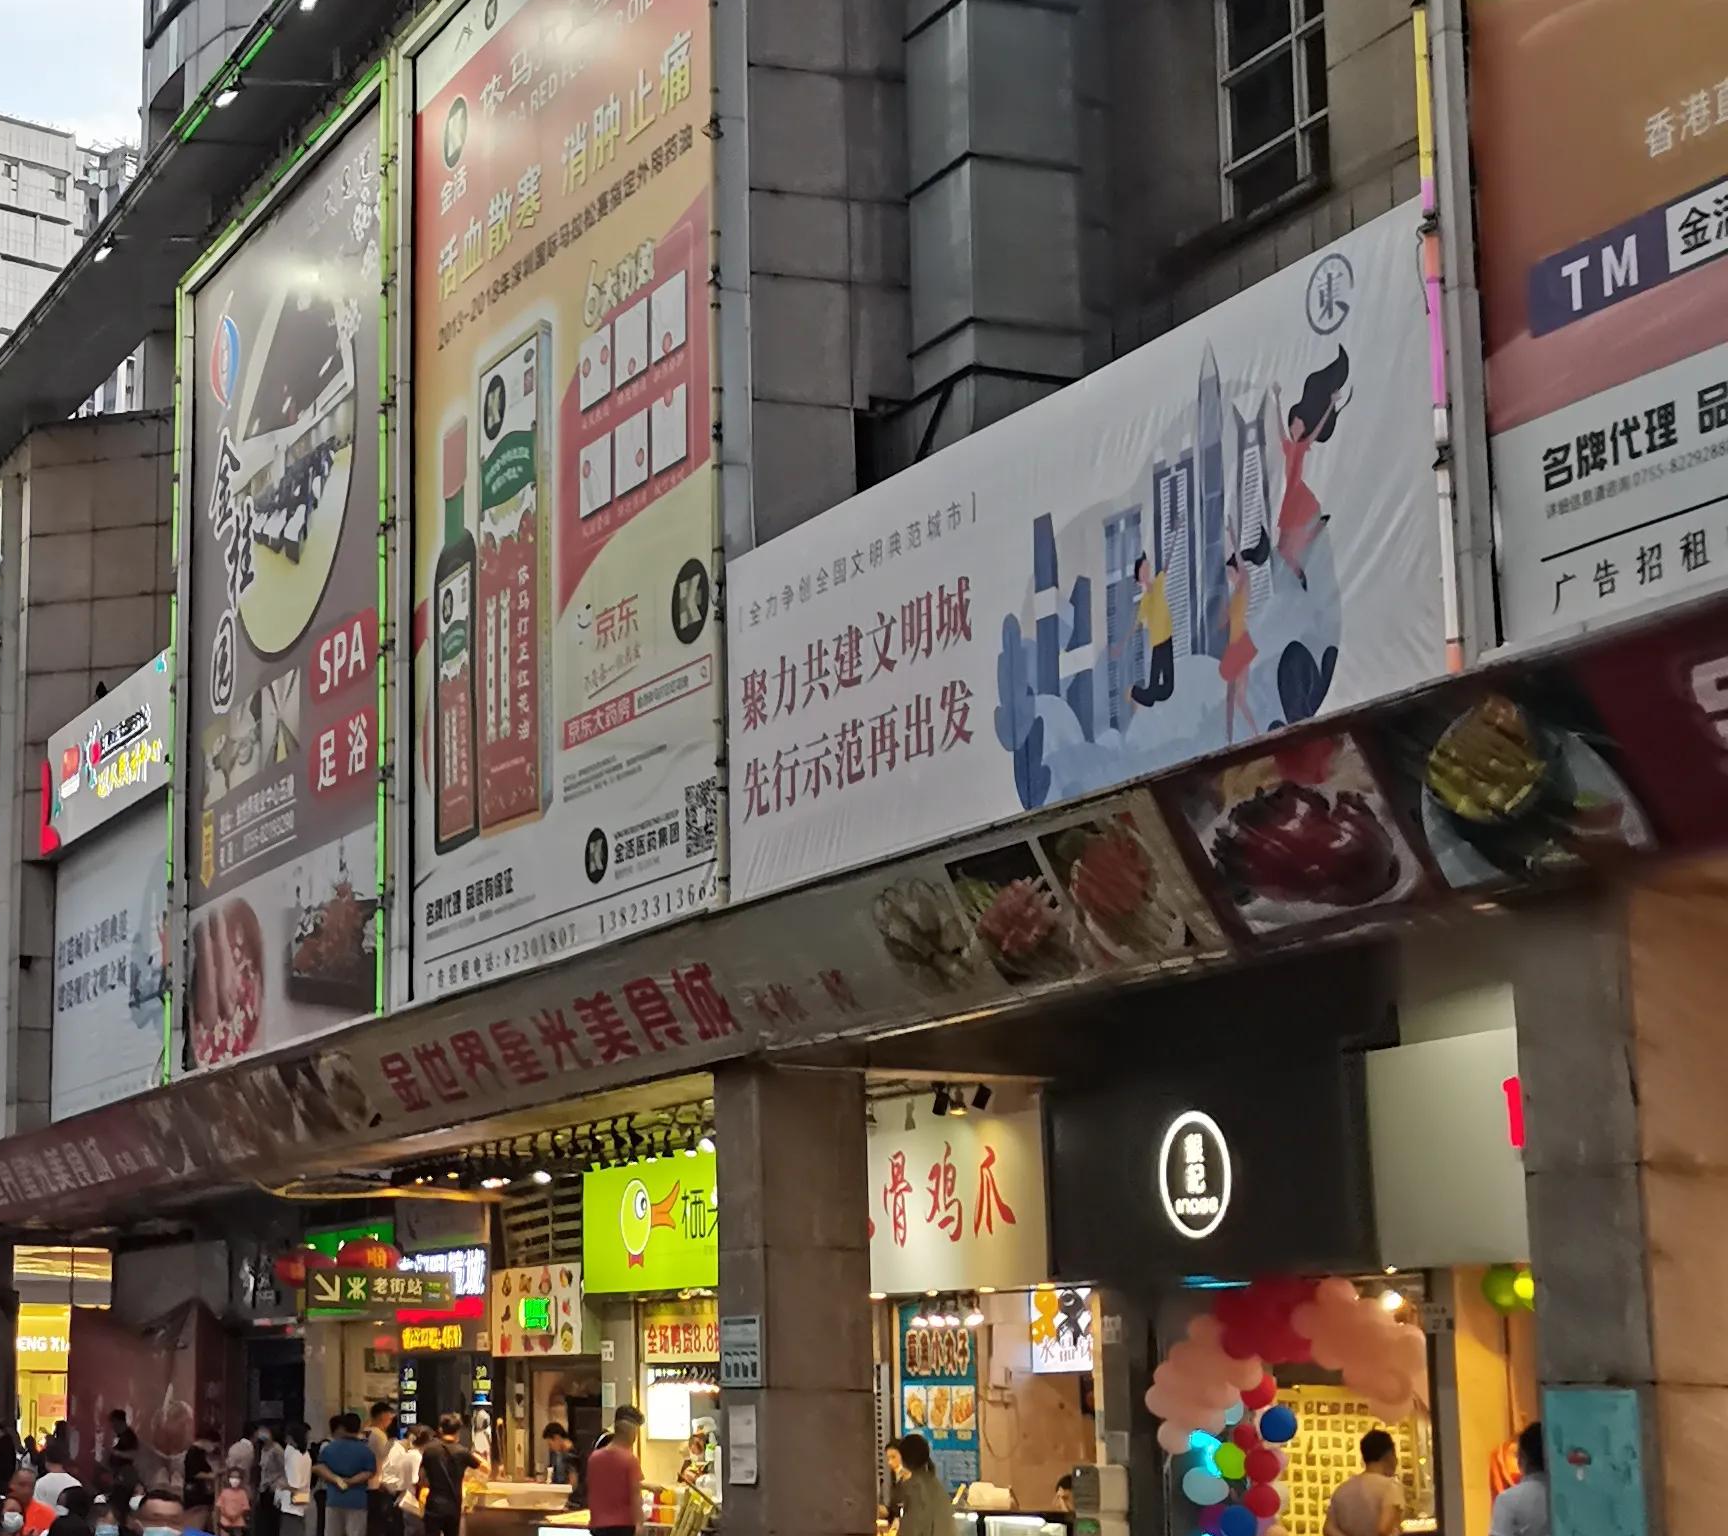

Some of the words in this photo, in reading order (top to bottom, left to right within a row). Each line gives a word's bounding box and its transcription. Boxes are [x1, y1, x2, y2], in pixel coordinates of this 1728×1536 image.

[561, 29, 693, 196] 消肿止痛
[438, 163, 542, 302] 活血散寒
[1561, 233, 1639, 312] TM
[1541, 400, 1679, 493] 名牌代理
[1552, 528, 1712, 615] 广告招租
[318, 620, 368, 697] SPA
[595, 593, 640, 652] 京东
[740, 575, 972, 735] 聚力共建文明城
[317, 712, 369, 793] 足浴
[741, 678, 974, 825] 先行示范再出发
[380, 960, 744, 1114] 金世界星光美食城
[868, 1140, 1017, 1249] 骨鸡爪
[372, 1276, 423, 1296] 老街站
